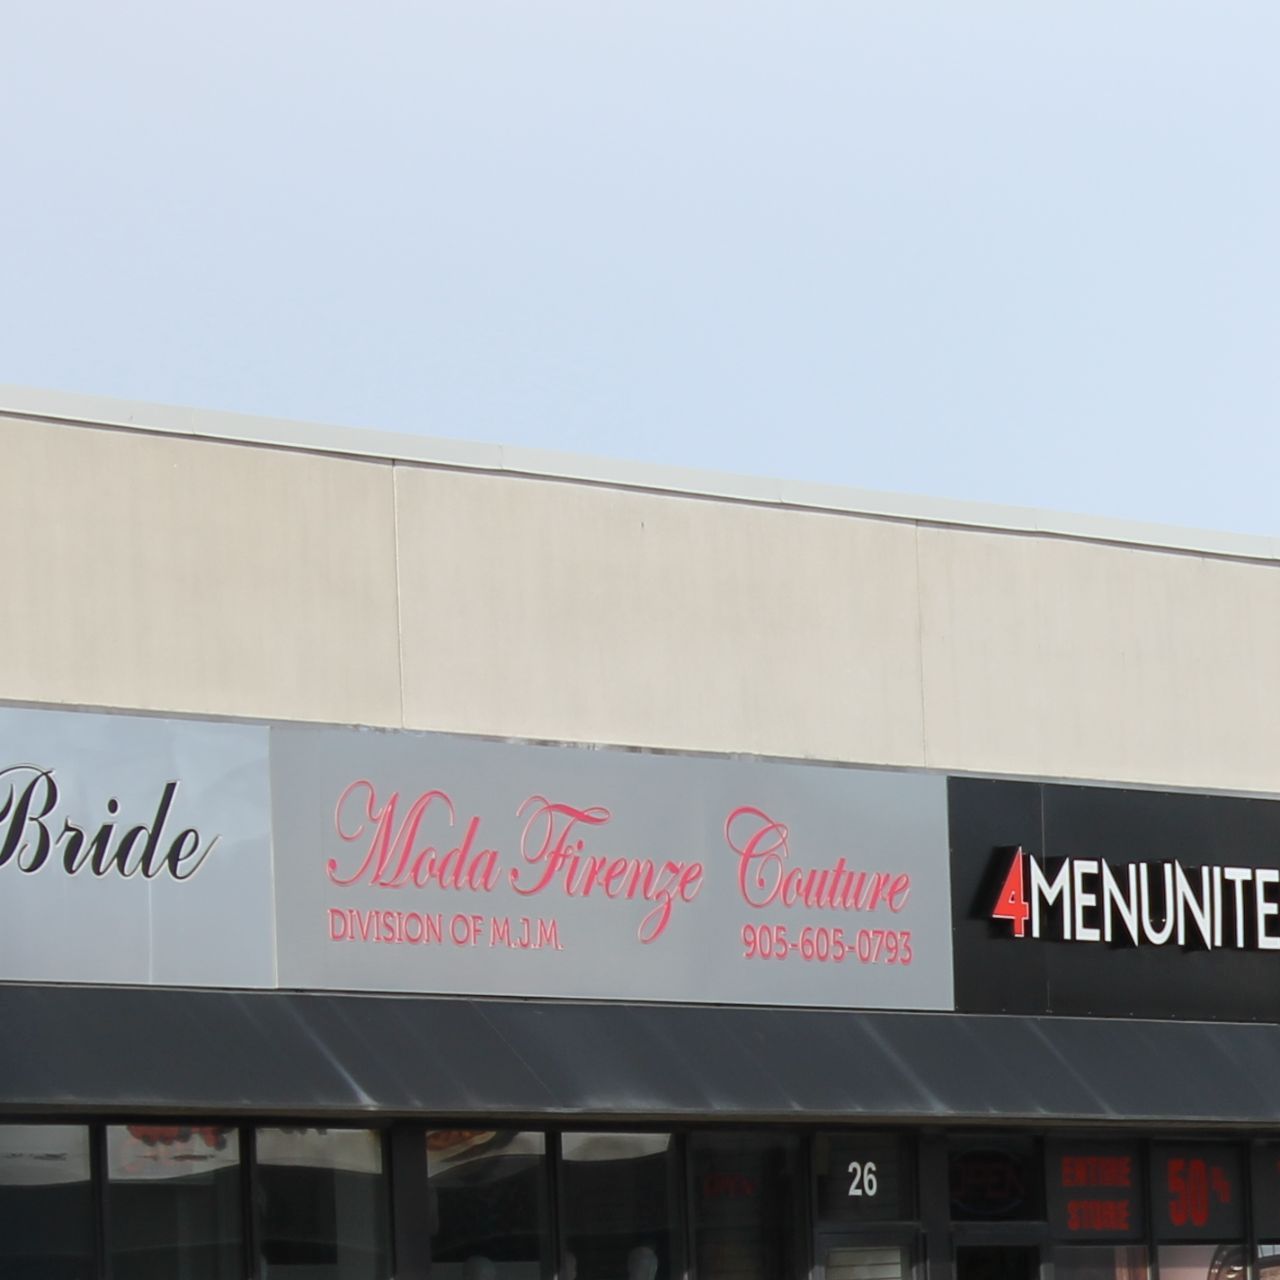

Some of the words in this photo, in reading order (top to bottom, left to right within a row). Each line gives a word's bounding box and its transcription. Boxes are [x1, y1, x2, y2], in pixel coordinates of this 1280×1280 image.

[326, 780, 501, 892] Moda
[508, 794, 704, 944] Firenze
[724, 805, 911, 913] Couture
[328, 908, 443, 944] DIVISION
[450, 913, 484, 946] OF
[489, 915, 565, 950] M.J.M.
[741, 923, 913, 966] 905-605-0793
[848, 1161, 878, 1197] 26
